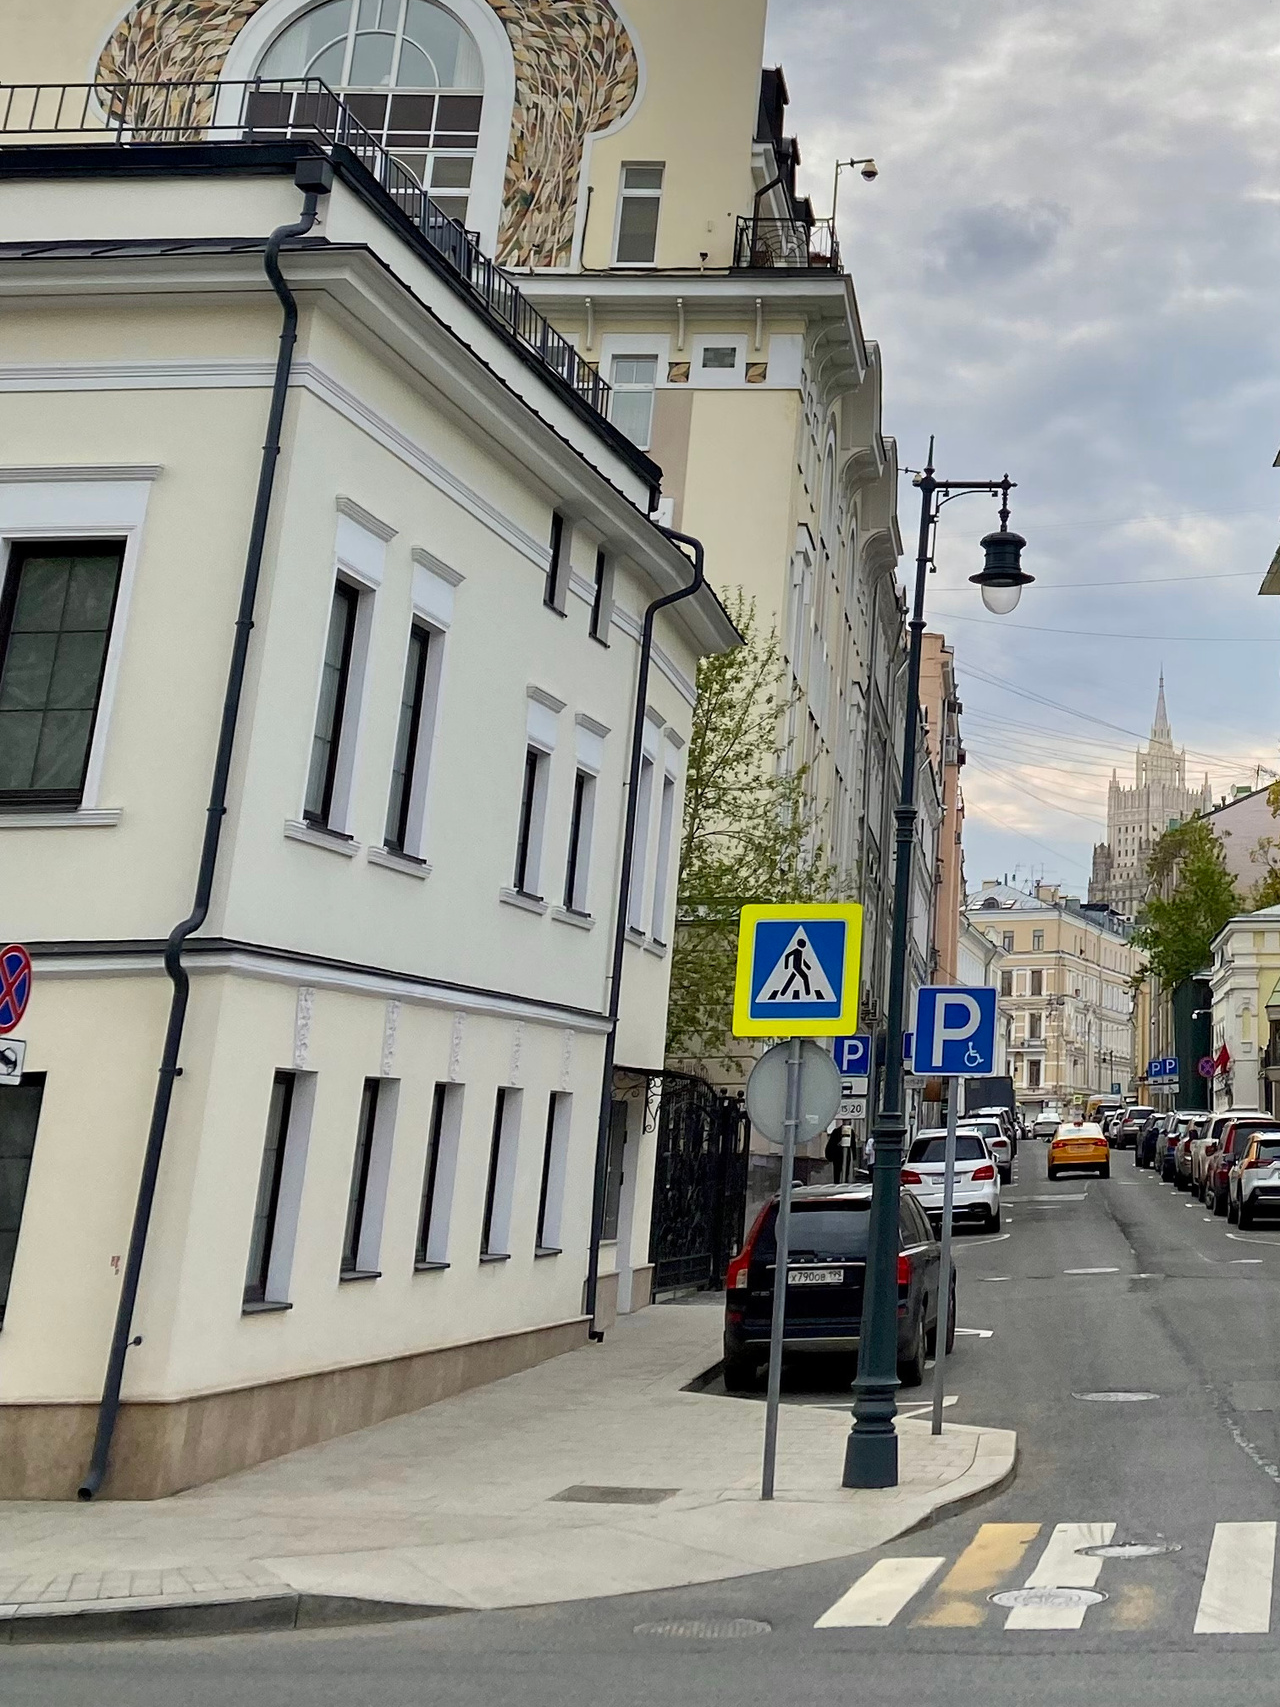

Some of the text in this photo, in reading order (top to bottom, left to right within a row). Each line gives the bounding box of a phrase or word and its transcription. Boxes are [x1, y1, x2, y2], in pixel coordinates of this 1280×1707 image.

[932, 993, 981, 1067] P
[842, 1039, 864, 1071] P
[1151, 1062, 1161, 1076] P
[1166, 1059, 1176, 1073] P
[841, 1104, 862, 1113] 15 20
